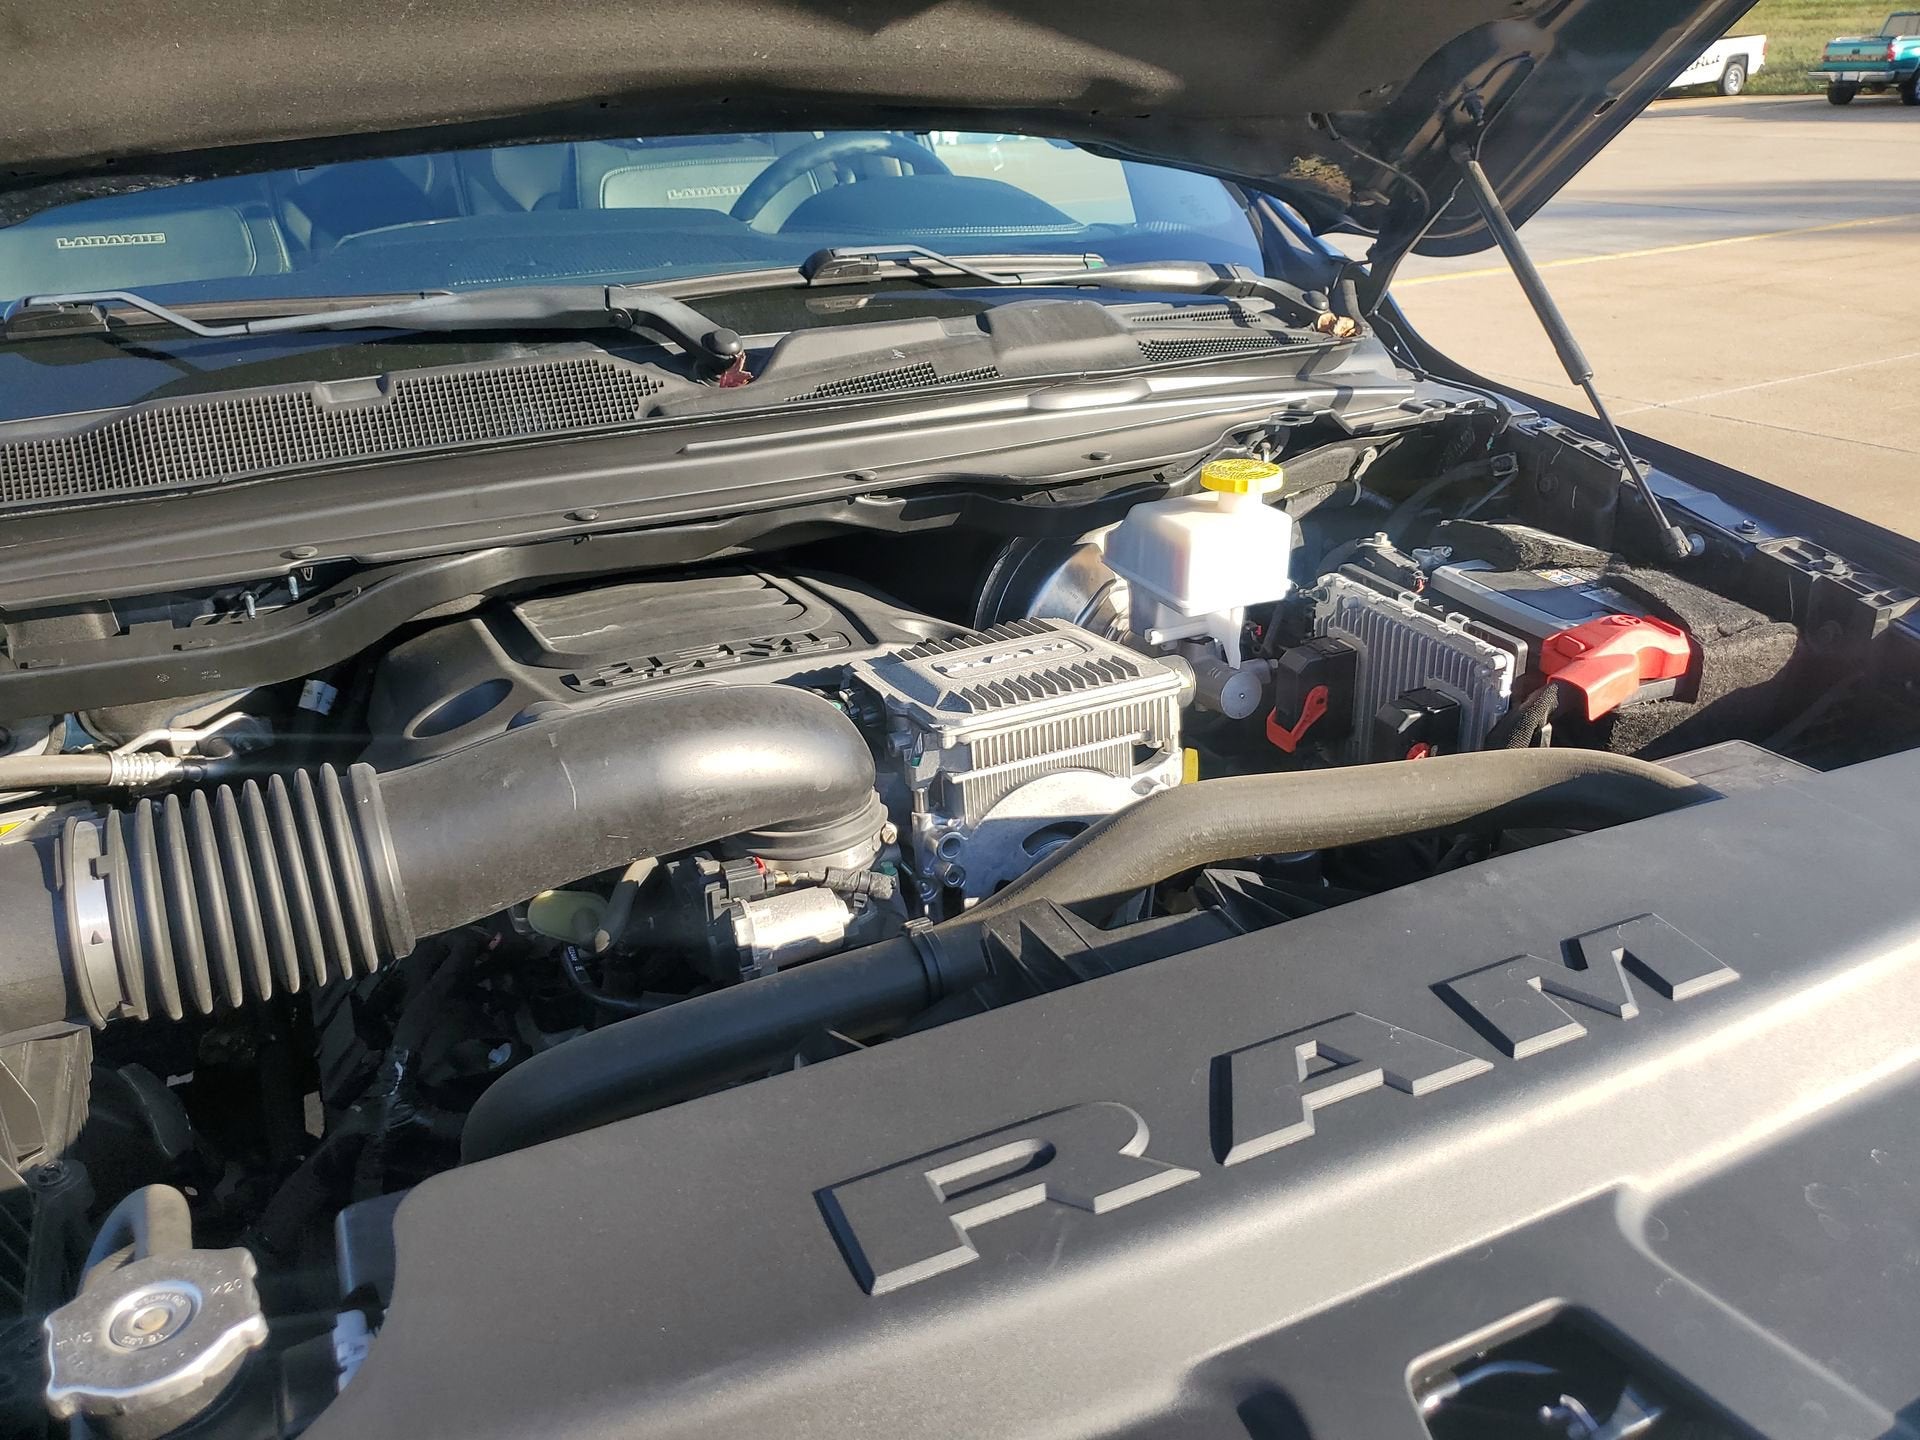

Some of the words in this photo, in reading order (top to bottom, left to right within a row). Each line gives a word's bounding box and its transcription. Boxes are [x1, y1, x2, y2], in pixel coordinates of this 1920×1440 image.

[666, 183, 748, 200] LARAMI
[57, 233, 166, 249] LARAMIE
[814, 912, 1741, 1297] RAM
